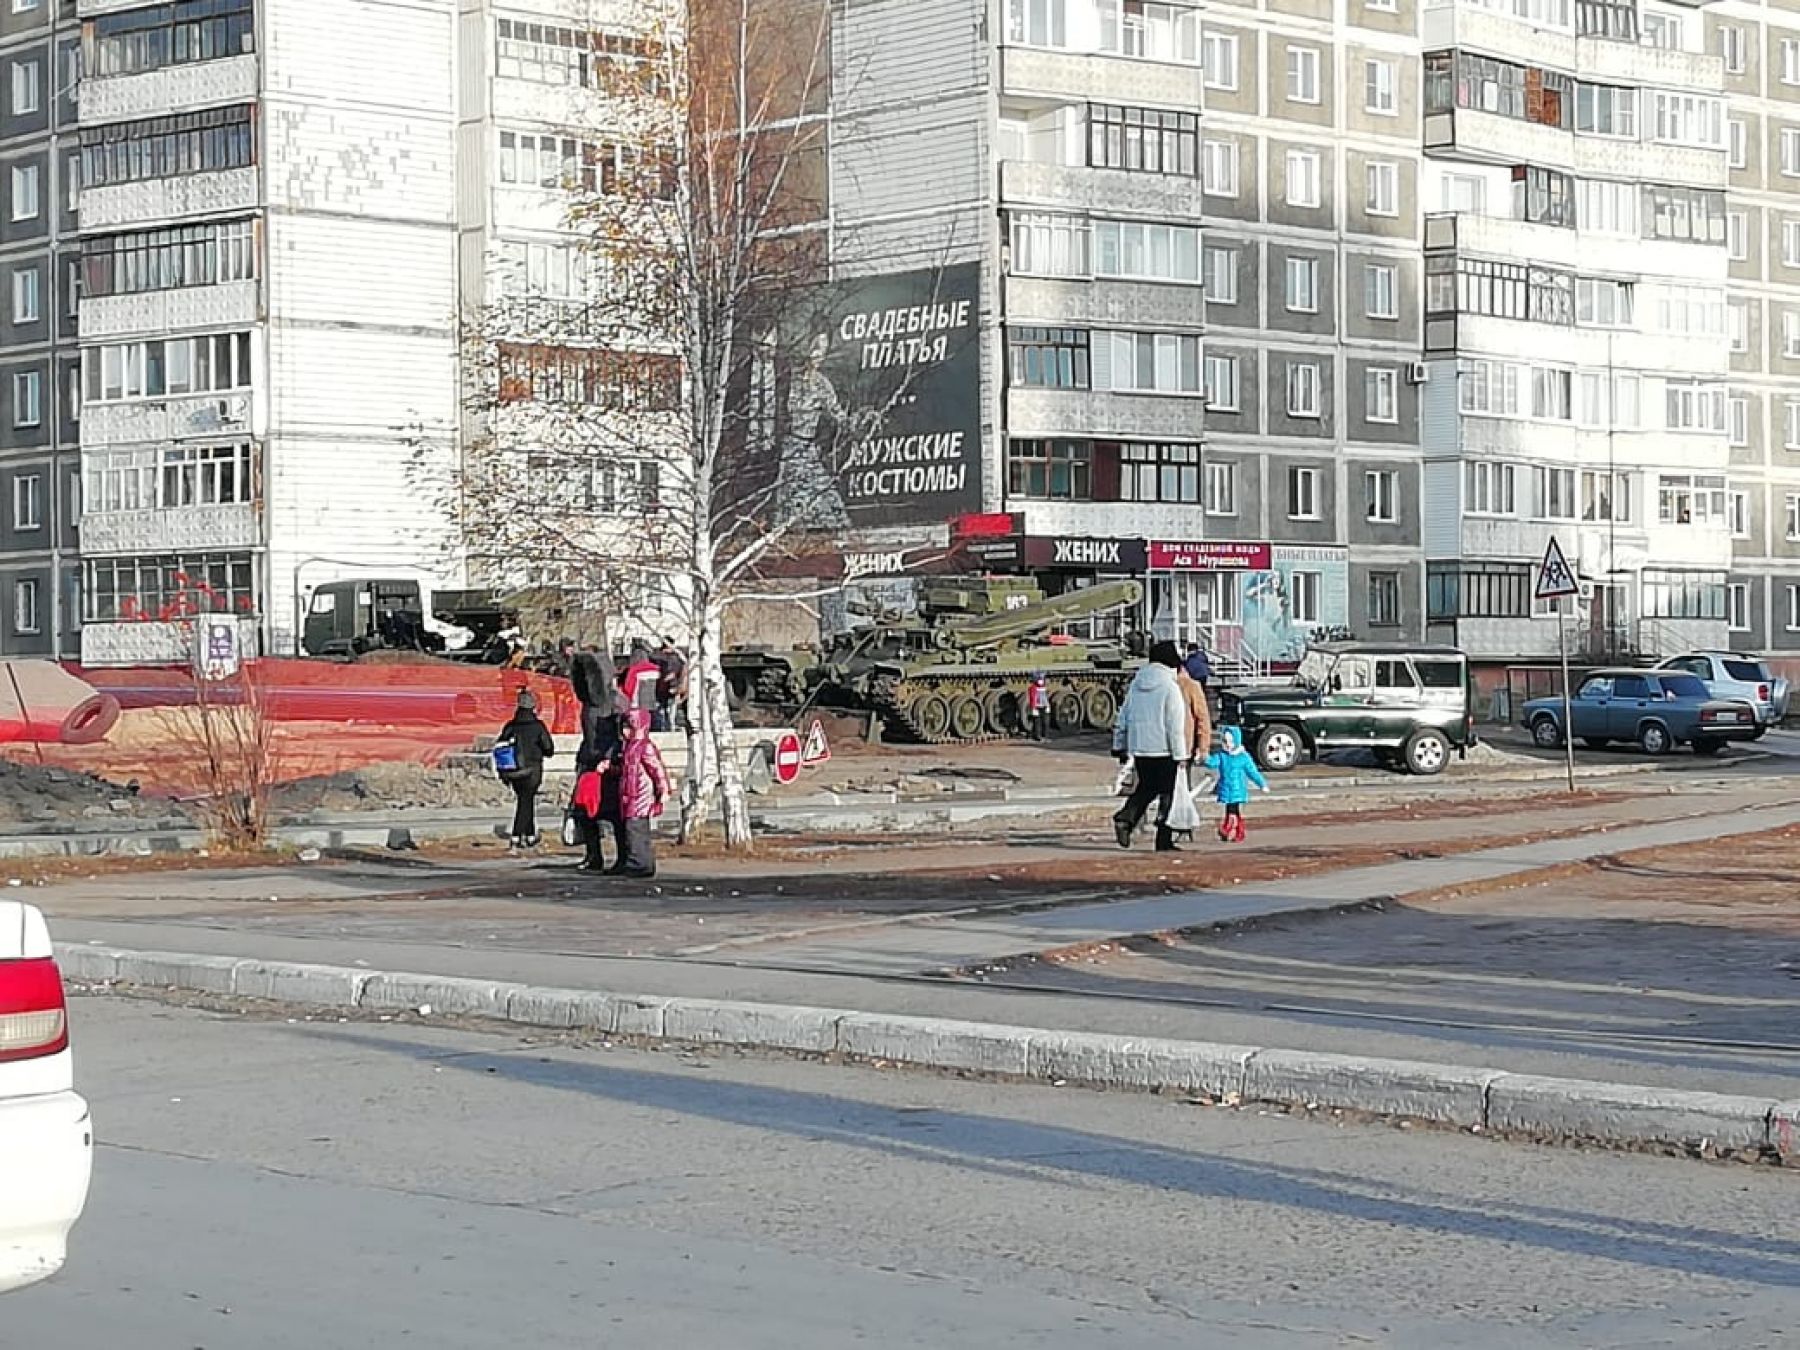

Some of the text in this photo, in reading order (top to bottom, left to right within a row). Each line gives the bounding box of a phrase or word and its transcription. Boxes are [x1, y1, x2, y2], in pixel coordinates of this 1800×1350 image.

[841, 300, 971, 341] СВАДЕБНЫЕ
[862, 335, 948, 369] ПЛАТЬЯ
[850, 431, 964, 466] МУЖСКИЕ
[848, 463, 967, 497] КОСТЮМЫ
[843, 552, 904, 574] ЖЕНИХ
[1053, 540, 1120, 563] ЖЕНИХ
